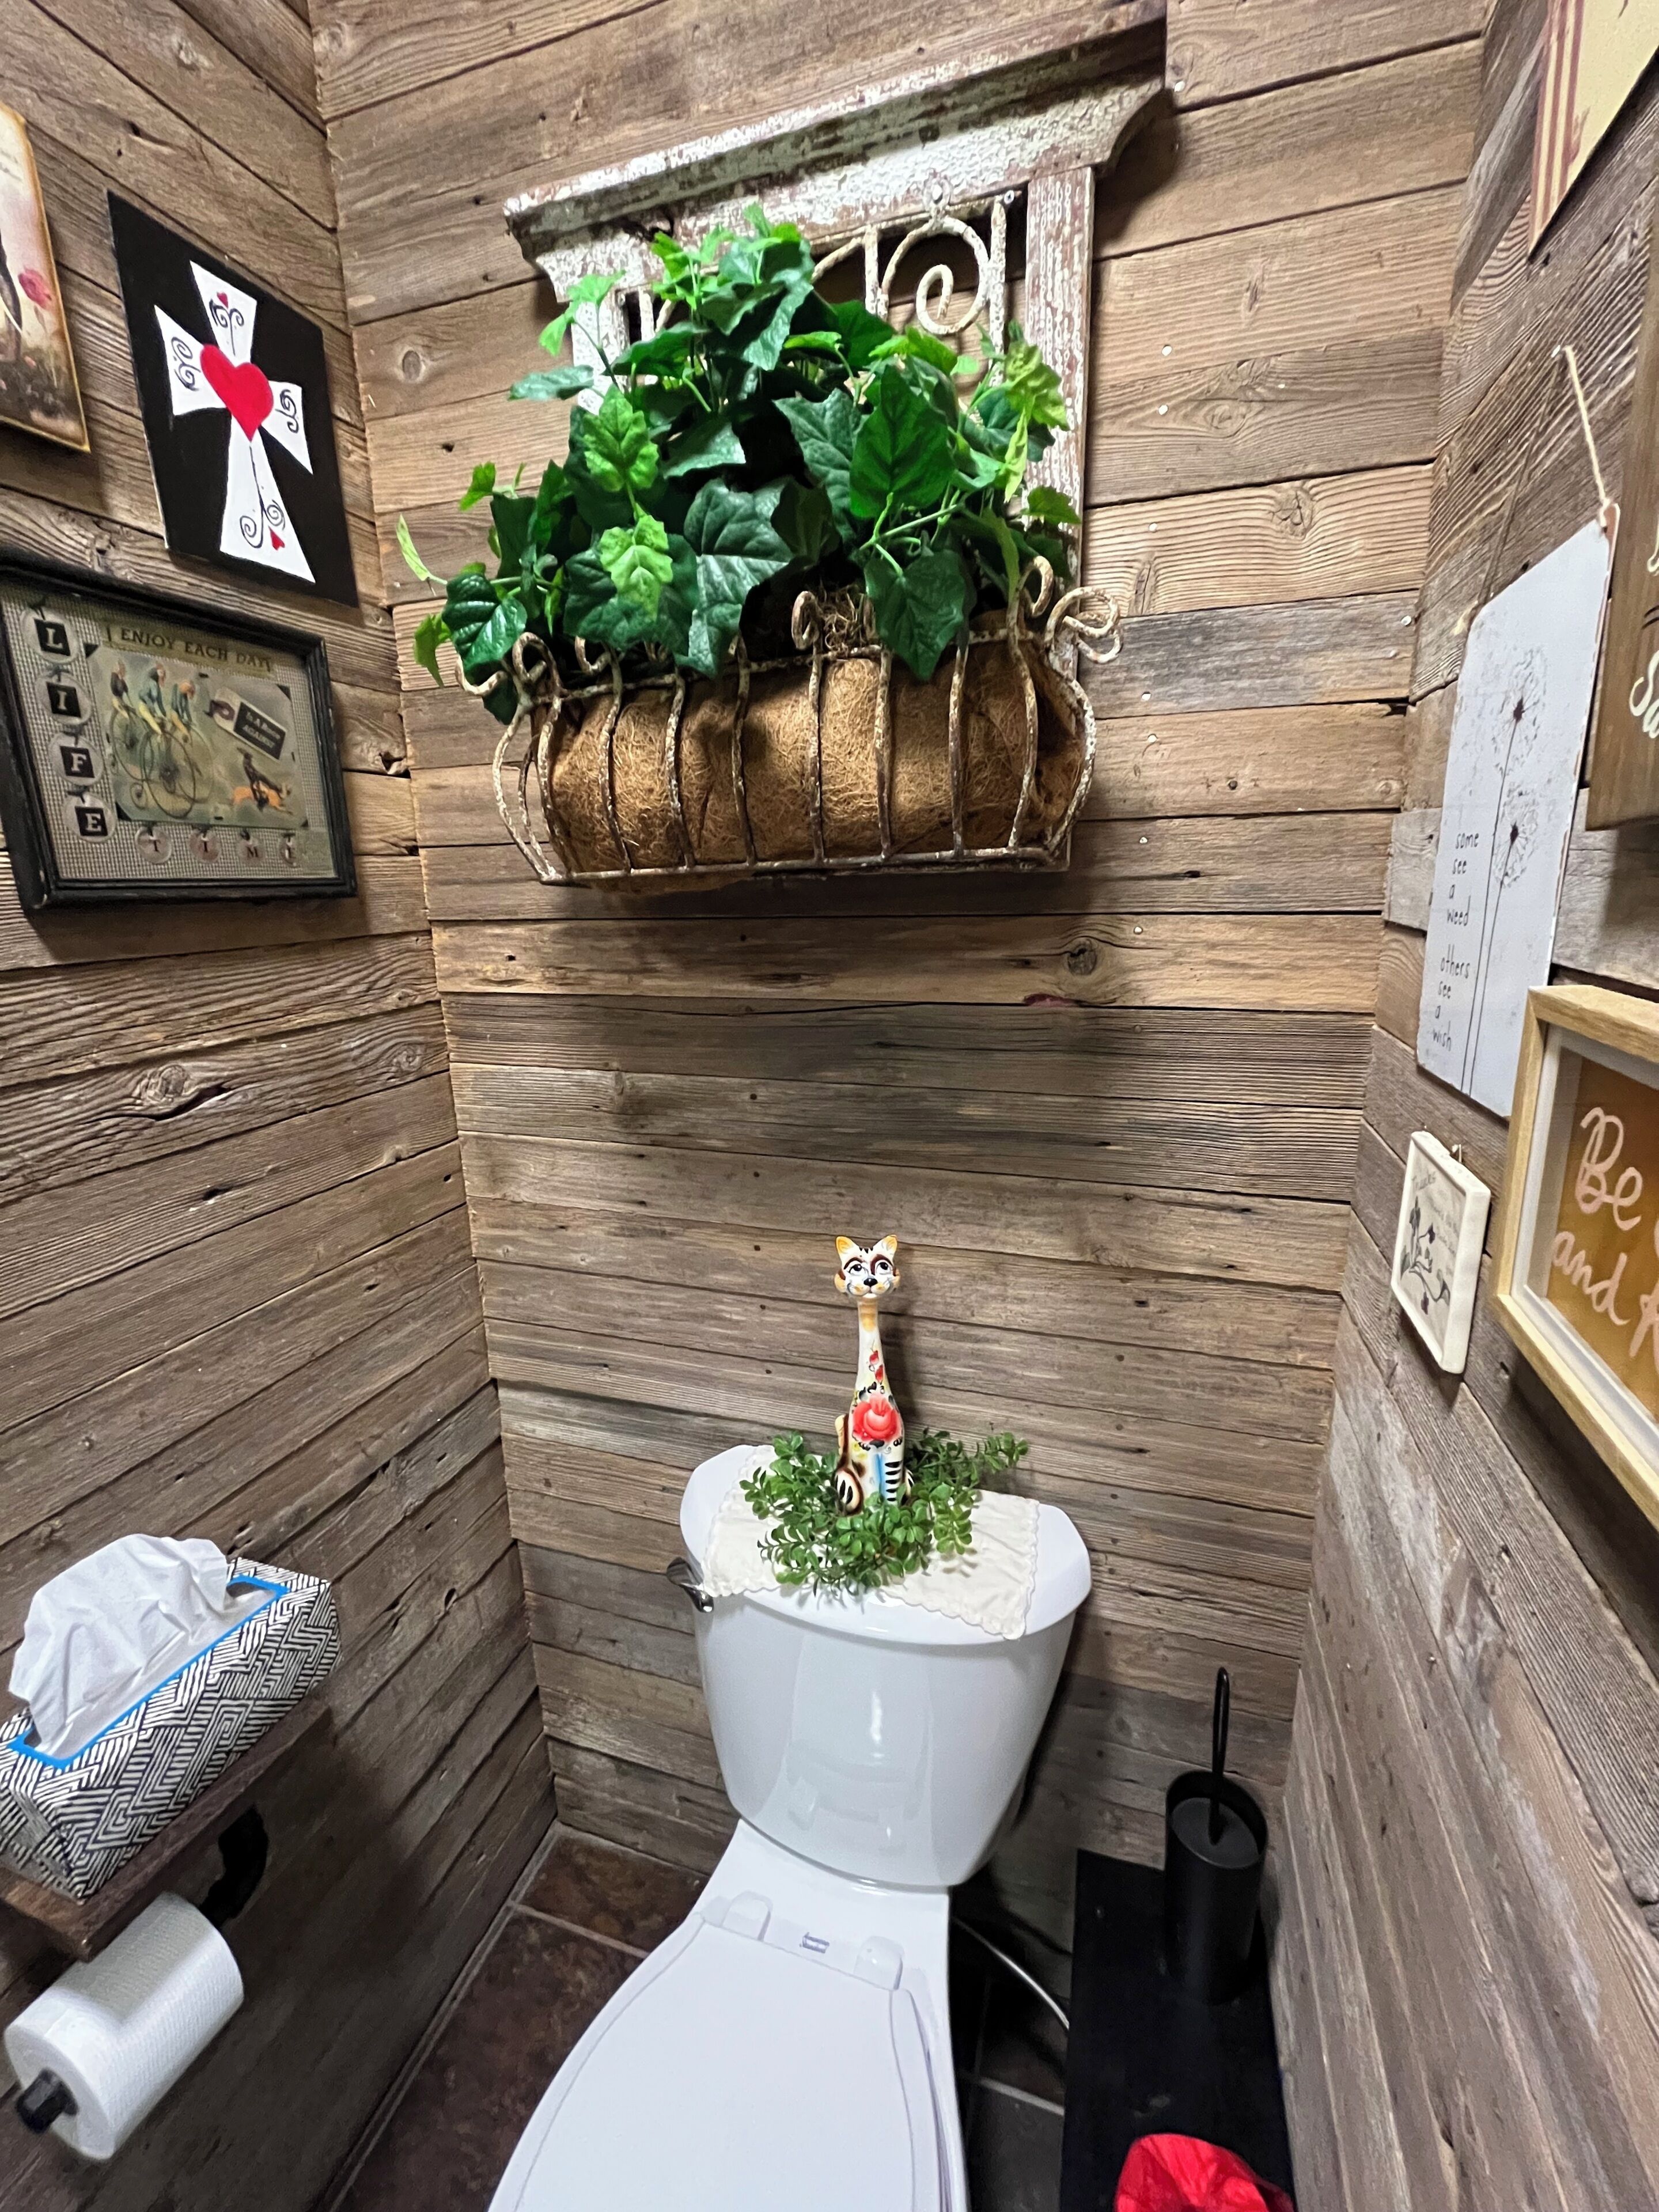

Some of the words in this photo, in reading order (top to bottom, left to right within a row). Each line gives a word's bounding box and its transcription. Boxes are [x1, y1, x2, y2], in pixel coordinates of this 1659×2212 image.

[121, 627, 174, 650] ENJOY
[185, 641, 228, 661] EACH
[1456, 833, 1479, 849] some
[1452, 858, 1467, 874] see
[1449, 884, 1455, 899] a
[1447, 895, 1471, 926] weed
[1441, 944, 1470, 979] others
[1438, 981, 1451, 999] see
[1435, 1005, 1441, 1019] a
[1433, 1020, 1452, 1052] wish
[1575, 1106, 1643, 1231] Be
[1552, 1230, 1630, 1325] and
